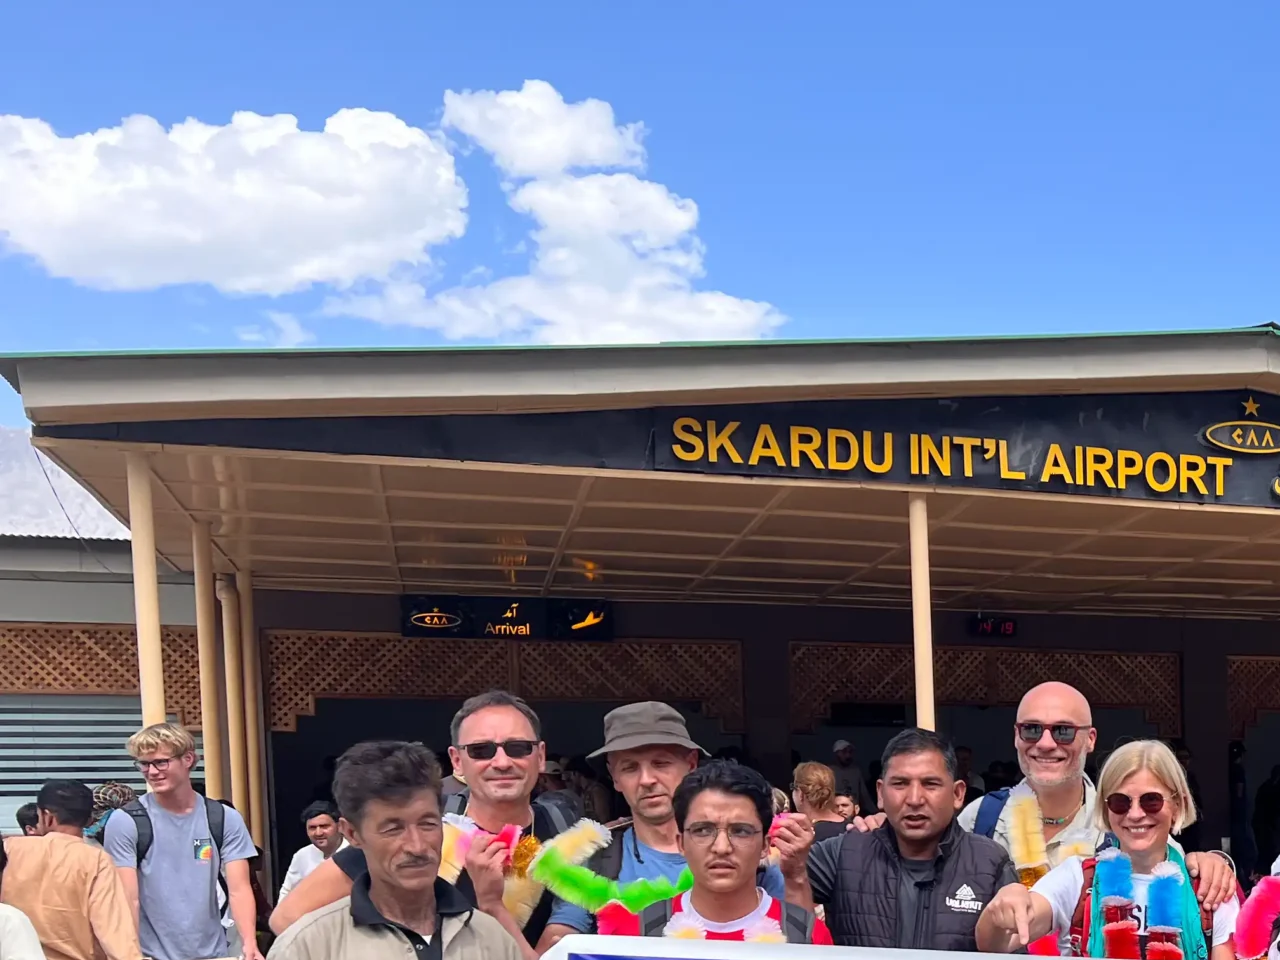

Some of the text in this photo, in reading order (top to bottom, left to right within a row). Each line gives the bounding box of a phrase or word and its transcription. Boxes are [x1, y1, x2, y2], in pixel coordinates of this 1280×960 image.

[1231, 427, 1275, 447] CAA
[671, 416, 1233, 497] SKARDU INT'L AIRPORT
[484, 621, 531, 636] Arrival
